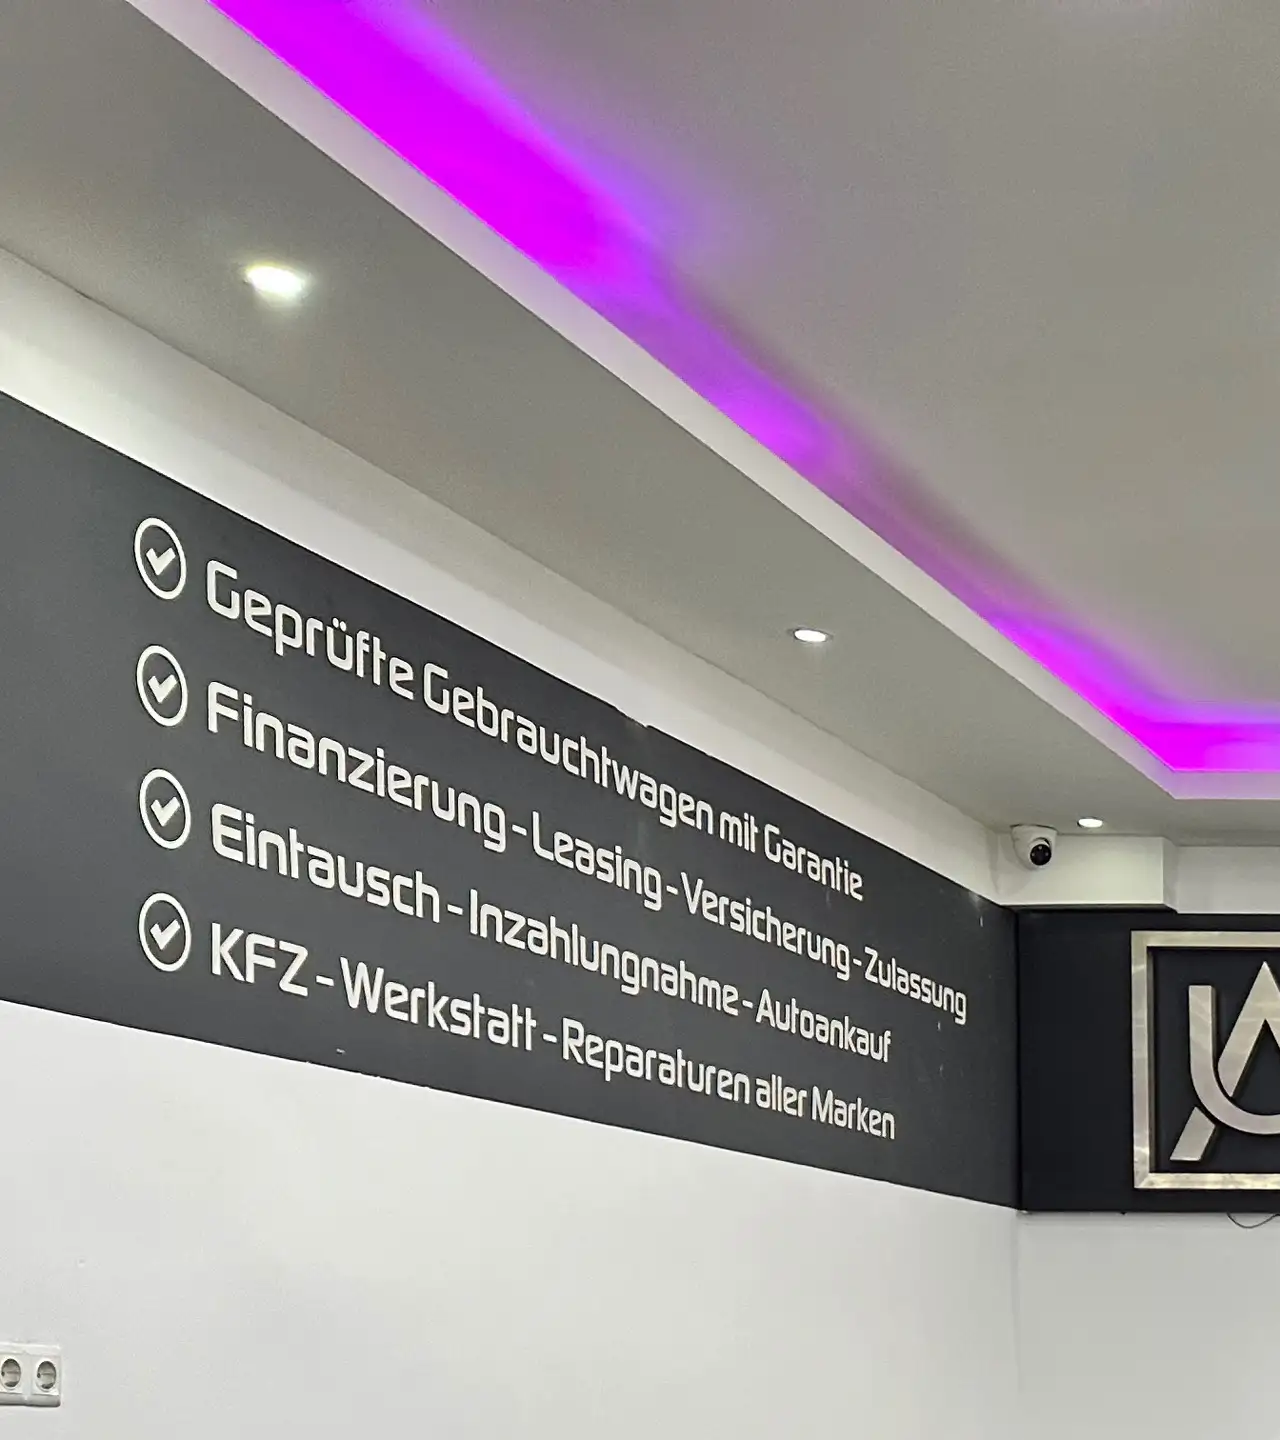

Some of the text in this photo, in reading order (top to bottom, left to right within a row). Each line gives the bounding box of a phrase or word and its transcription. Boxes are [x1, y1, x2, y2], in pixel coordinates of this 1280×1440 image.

[207, 560, 864, 901] Geprüfte Gebrauchtwagen mit Garantie
[562, 1017, 749, 1105] Reparaturen
[755, 1075, 807, 1118] aller
[811, 1086, 895, 1140] Marken
